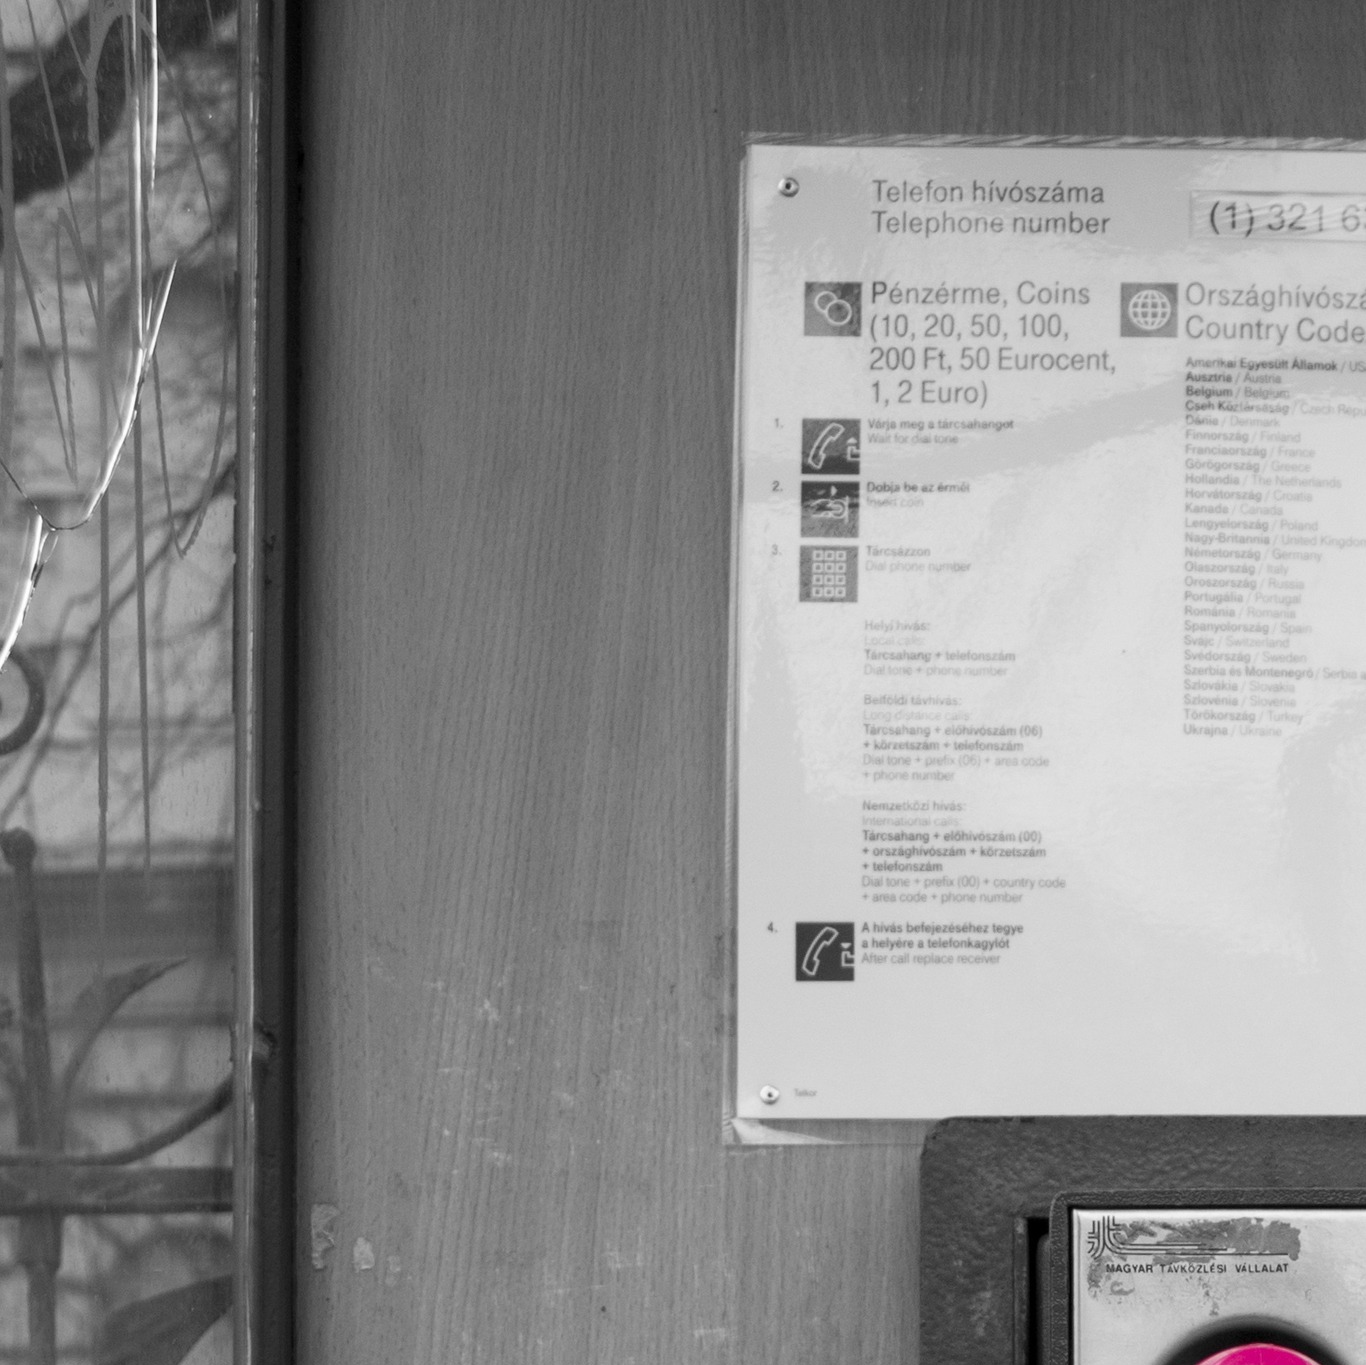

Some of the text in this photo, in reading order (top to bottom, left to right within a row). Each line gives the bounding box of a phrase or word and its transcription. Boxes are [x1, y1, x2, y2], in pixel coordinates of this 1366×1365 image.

[872, 179, 1104, 203] Telefon hívószáma
[871, 210, 1110, 236] Telephone number
[1209, 201, 1255, 236] (1)
[1265, 204, 1324, 232] 321
[871, 280, 1090, 306] Pénzérme, Coins
[869, 313, 1068, 342] (10, 20, 50, 100,
[1184, 315, 1288, 345] Country
[869, 346, 1115, 373] 200 Ft, 50 Eurocent,
[871, 379, 988, 408] 1, 2 Euro)
[867, 418, 1014, 432] Várja meg a tárcsahangot
[860, 921, 1024, 936] A hívás befejezéséhez tegye
[860, 937, 1010, 951] a helyére a telefonkagylót
